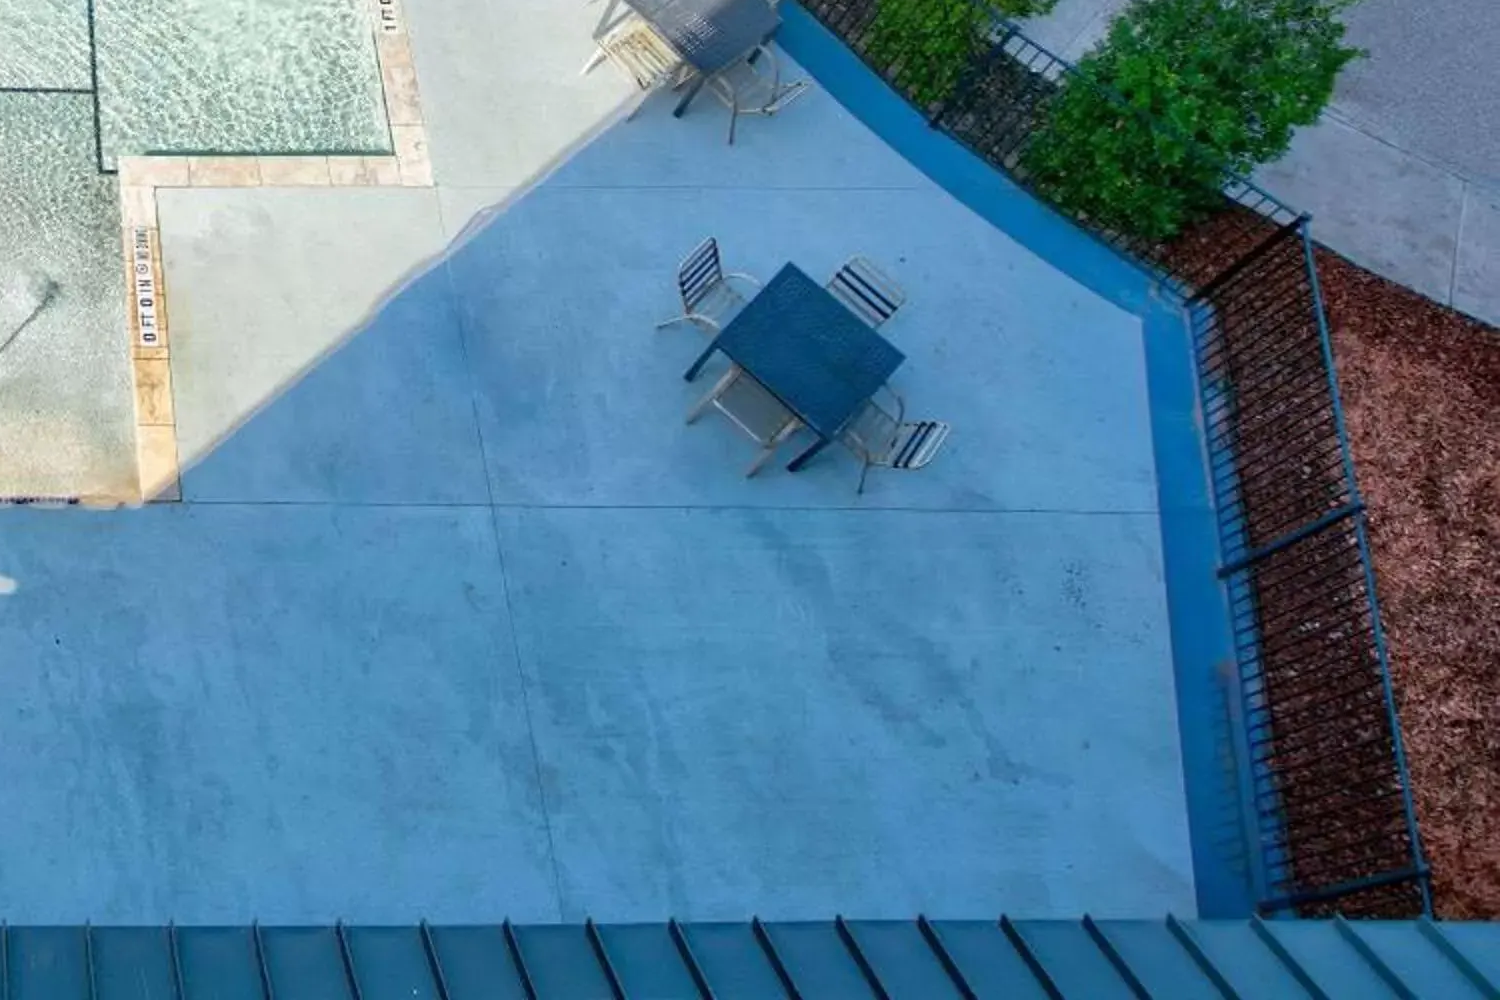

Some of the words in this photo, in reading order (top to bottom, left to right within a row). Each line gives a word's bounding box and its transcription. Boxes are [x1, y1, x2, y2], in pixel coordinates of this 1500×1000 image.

[381, 8, 395, 21] FT
[138, 279, 152, 292] IN
[140, 298, 153, 307] 0
[141, 312, 155, 327] FT
[143, 333, 157, 342] 0
